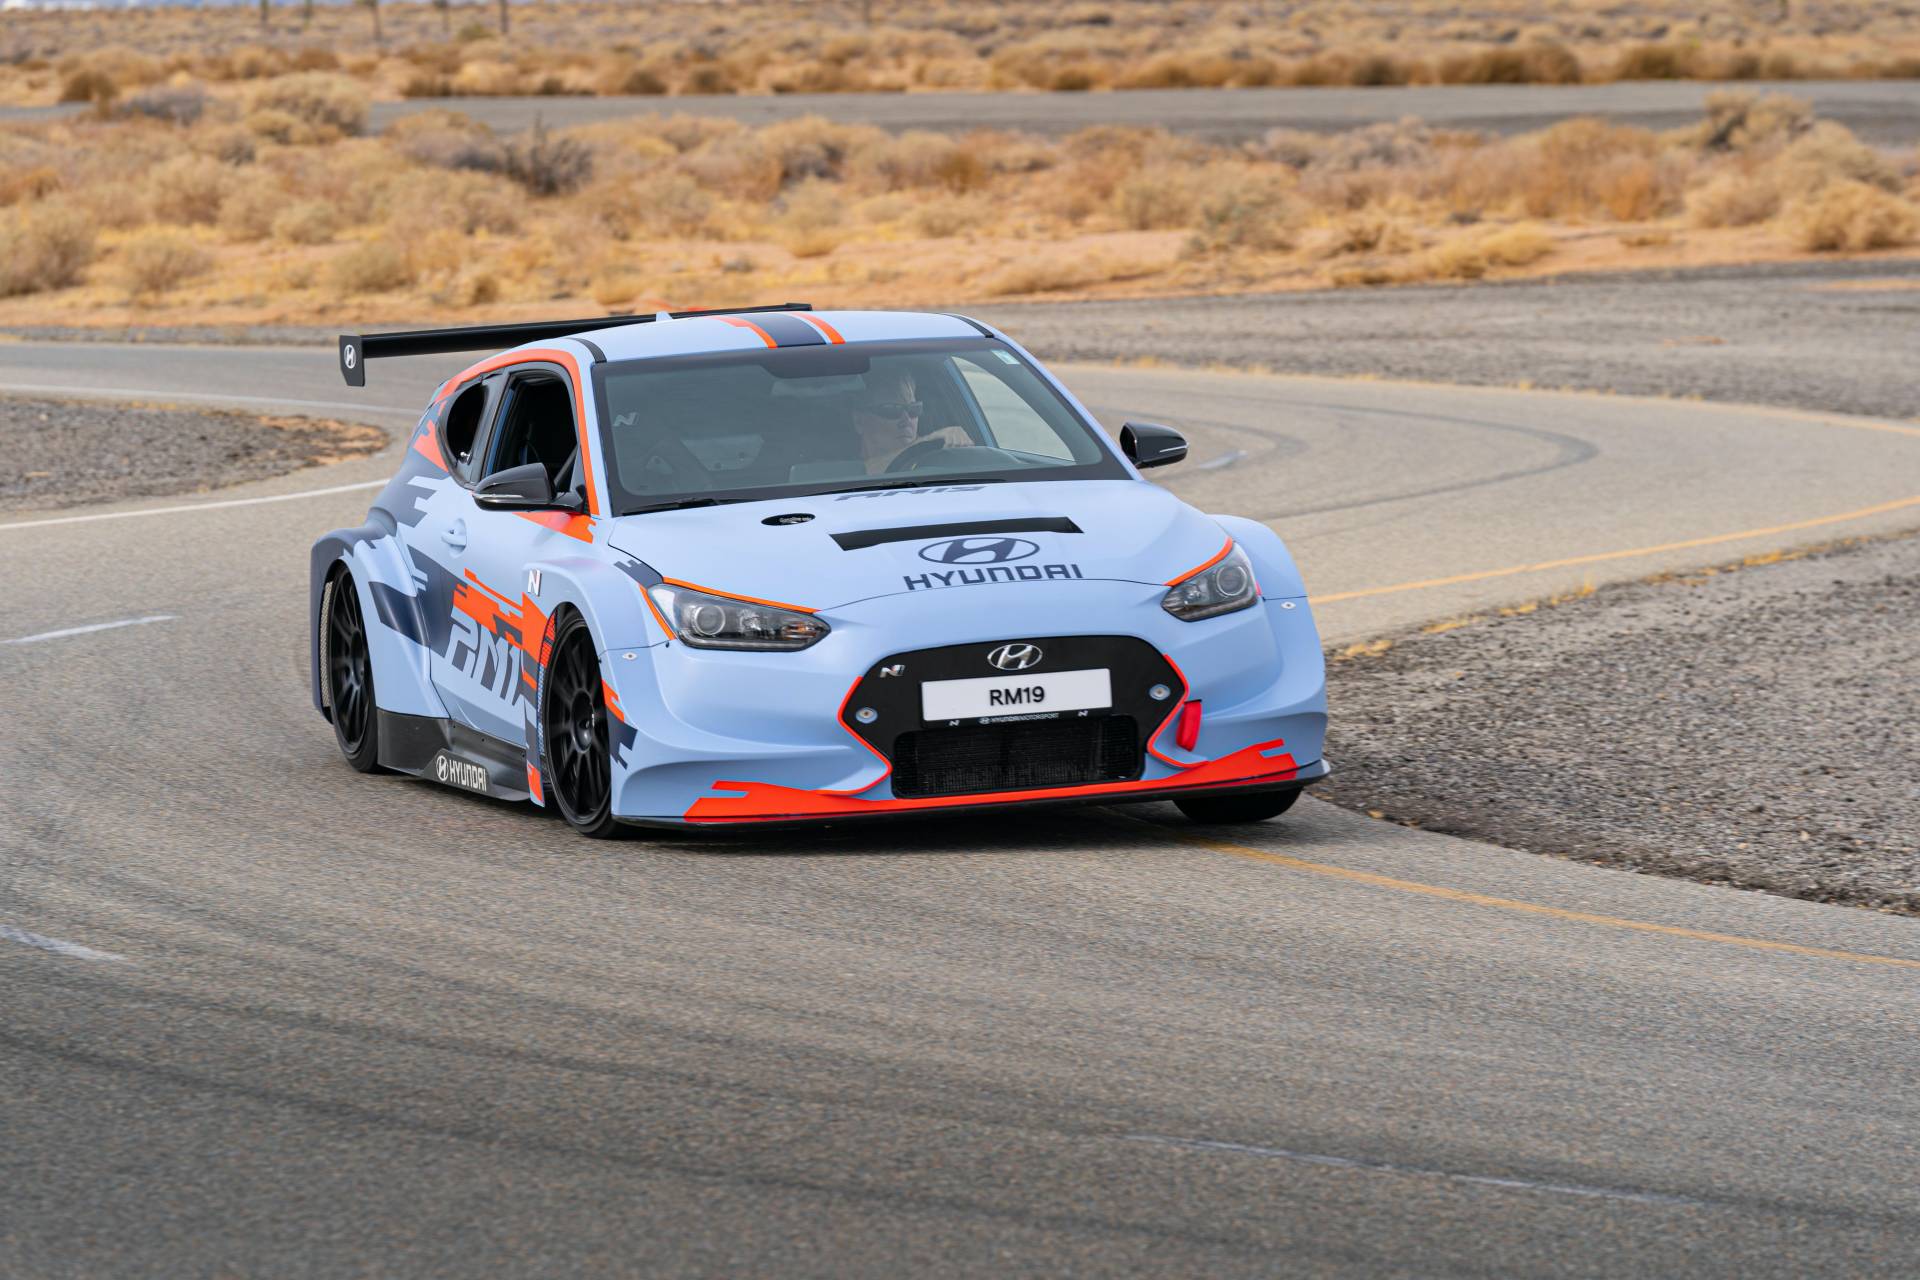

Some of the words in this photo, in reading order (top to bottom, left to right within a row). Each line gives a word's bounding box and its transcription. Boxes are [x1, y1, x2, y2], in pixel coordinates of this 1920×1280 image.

[903, 563, 1084, 590] HYUNDAI
[989, 685, 1045, 706] RM19
[449, 759, 487, 792] HYUNDAI
